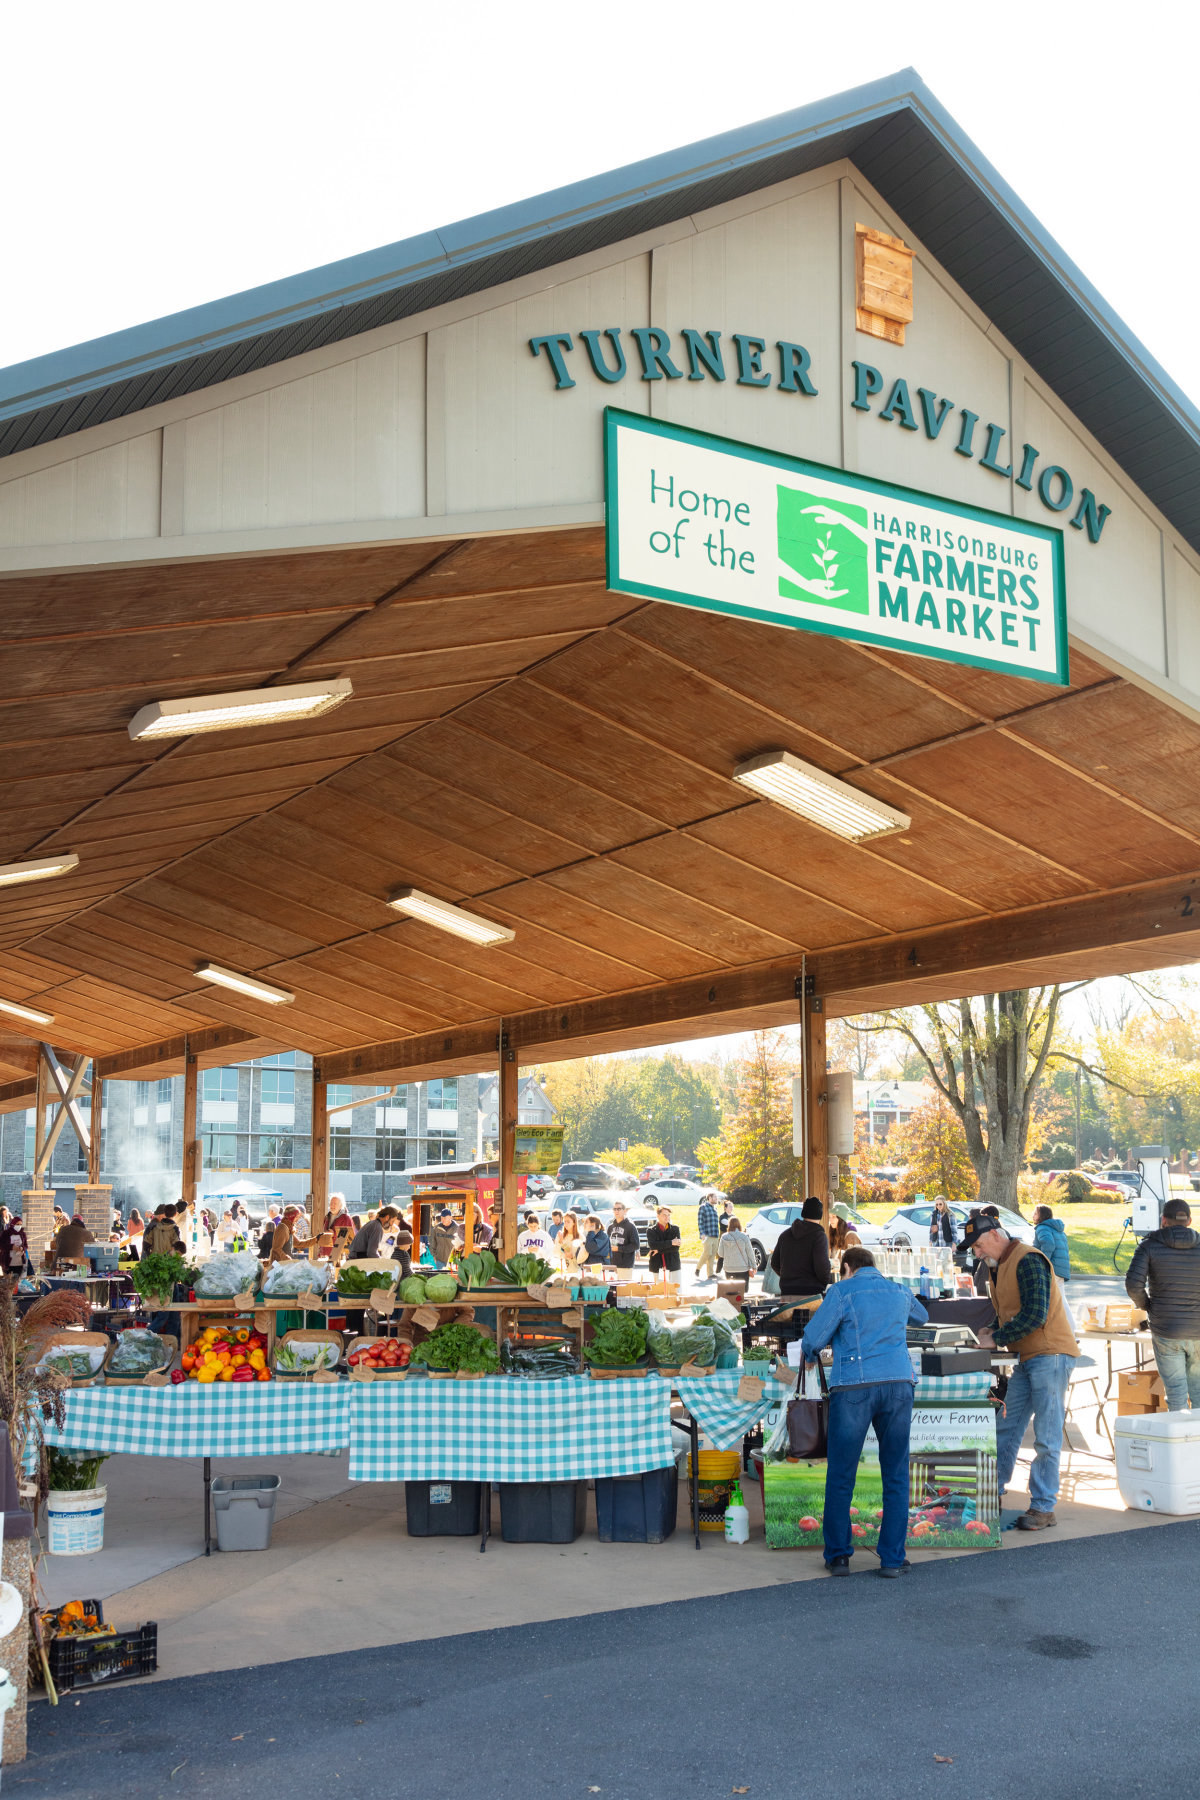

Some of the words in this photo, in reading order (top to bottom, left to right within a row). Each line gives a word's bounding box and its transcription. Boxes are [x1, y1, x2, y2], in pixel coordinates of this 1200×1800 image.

[530, 327, 818, 396] TURNER
[850, 360, 1112, 544] PAVILION
[650, 469, 750, 527] Home
[649, 518, 690, 559] of
[703, 528, 755, 575] the
[875, 537, 1040, 611] FARMERS
[878, 580, 1041, 652] MARKET
[1181, 896, 1193, 917] 2
[483, 1190, 494, 1199] KET
[524, 1239, 545, 1248] JMU
[949, 1412, 990, 1425] Farm
